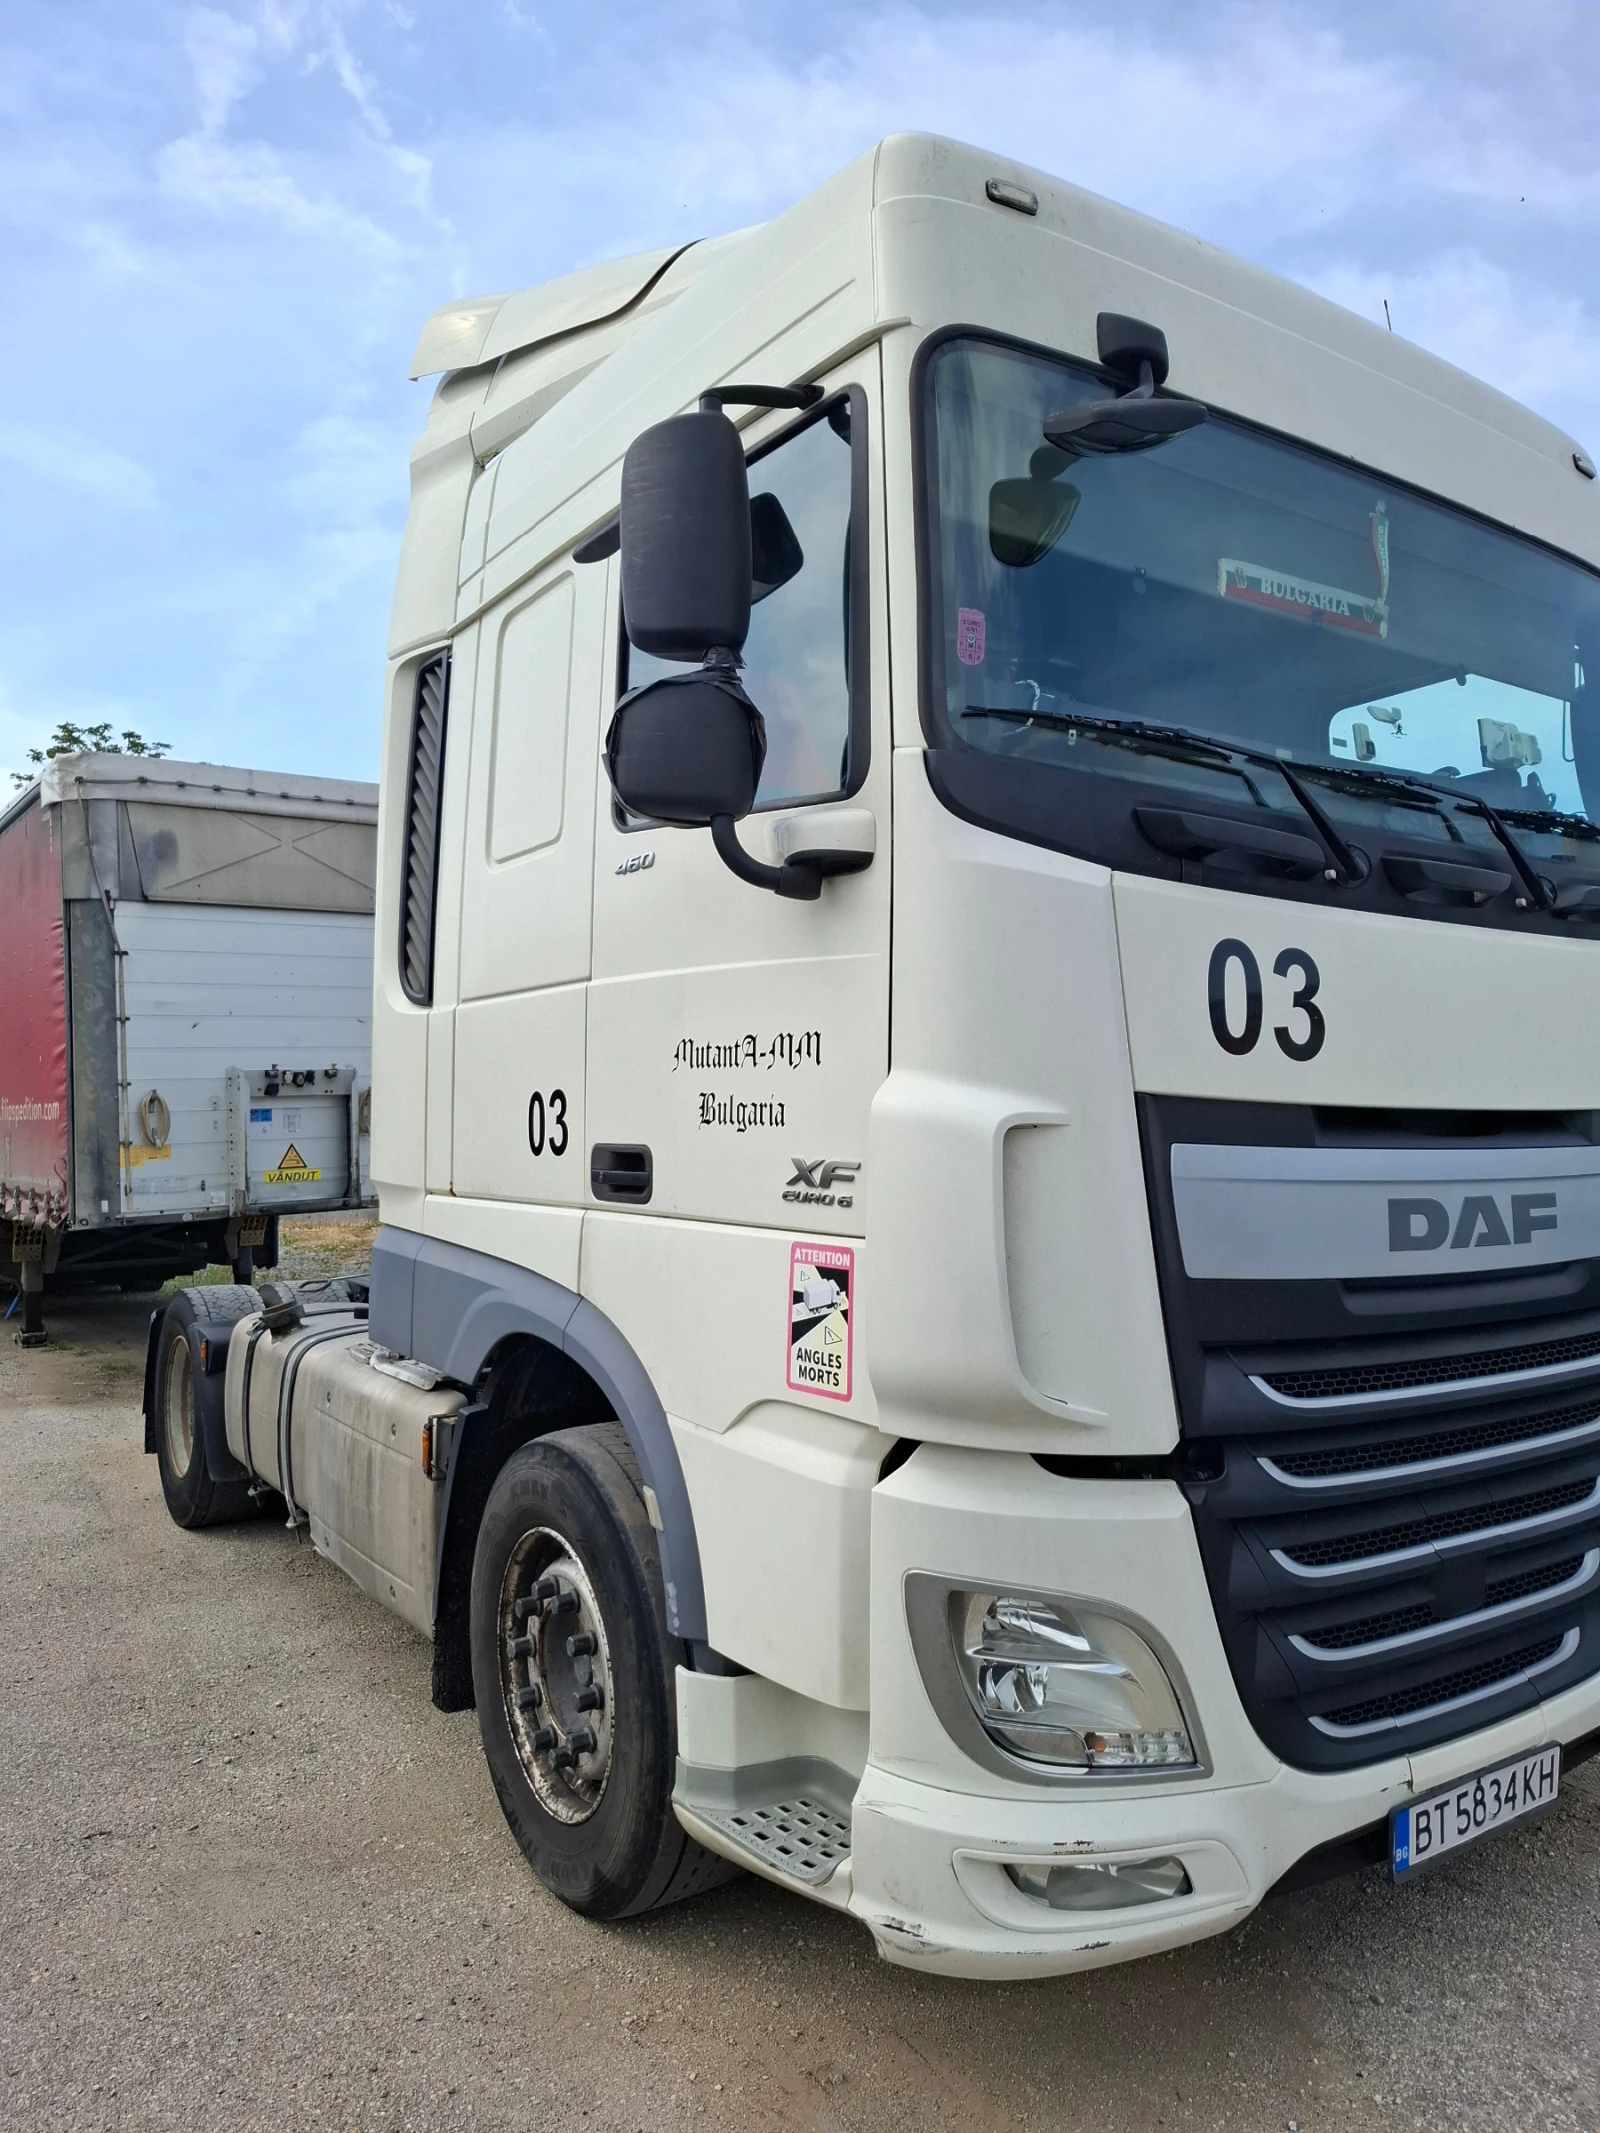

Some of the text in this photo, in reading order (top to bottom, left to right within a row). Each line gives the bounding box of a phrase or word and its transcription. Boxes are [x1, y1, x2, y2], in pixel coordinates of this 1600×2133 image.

[1260, 577, 1350, 616] BULGARIA
[963, 619, 981, 627] EURO
[615, 851, 655, 875] 460
[1207, 937, 1326, 1062] 03
[528, 1088, 569, 1157] 03
[698, 1091, 786, 1133] Bulgaria
[268, 1170, 319, 1183] VÂNDUT
[785, 1157, 861, 1189] XF
[782, 1189, 853, 1208] EURO 6
[1387, 1192, 1558, 1252] DAF
[794, 1247, 851, 1267] ATTENTION
[796, 1347, 843, 1370] ANGLES
[798, 1364, 840, 1387] MORTS
[1396, 1846, 1409, 1863] BG
